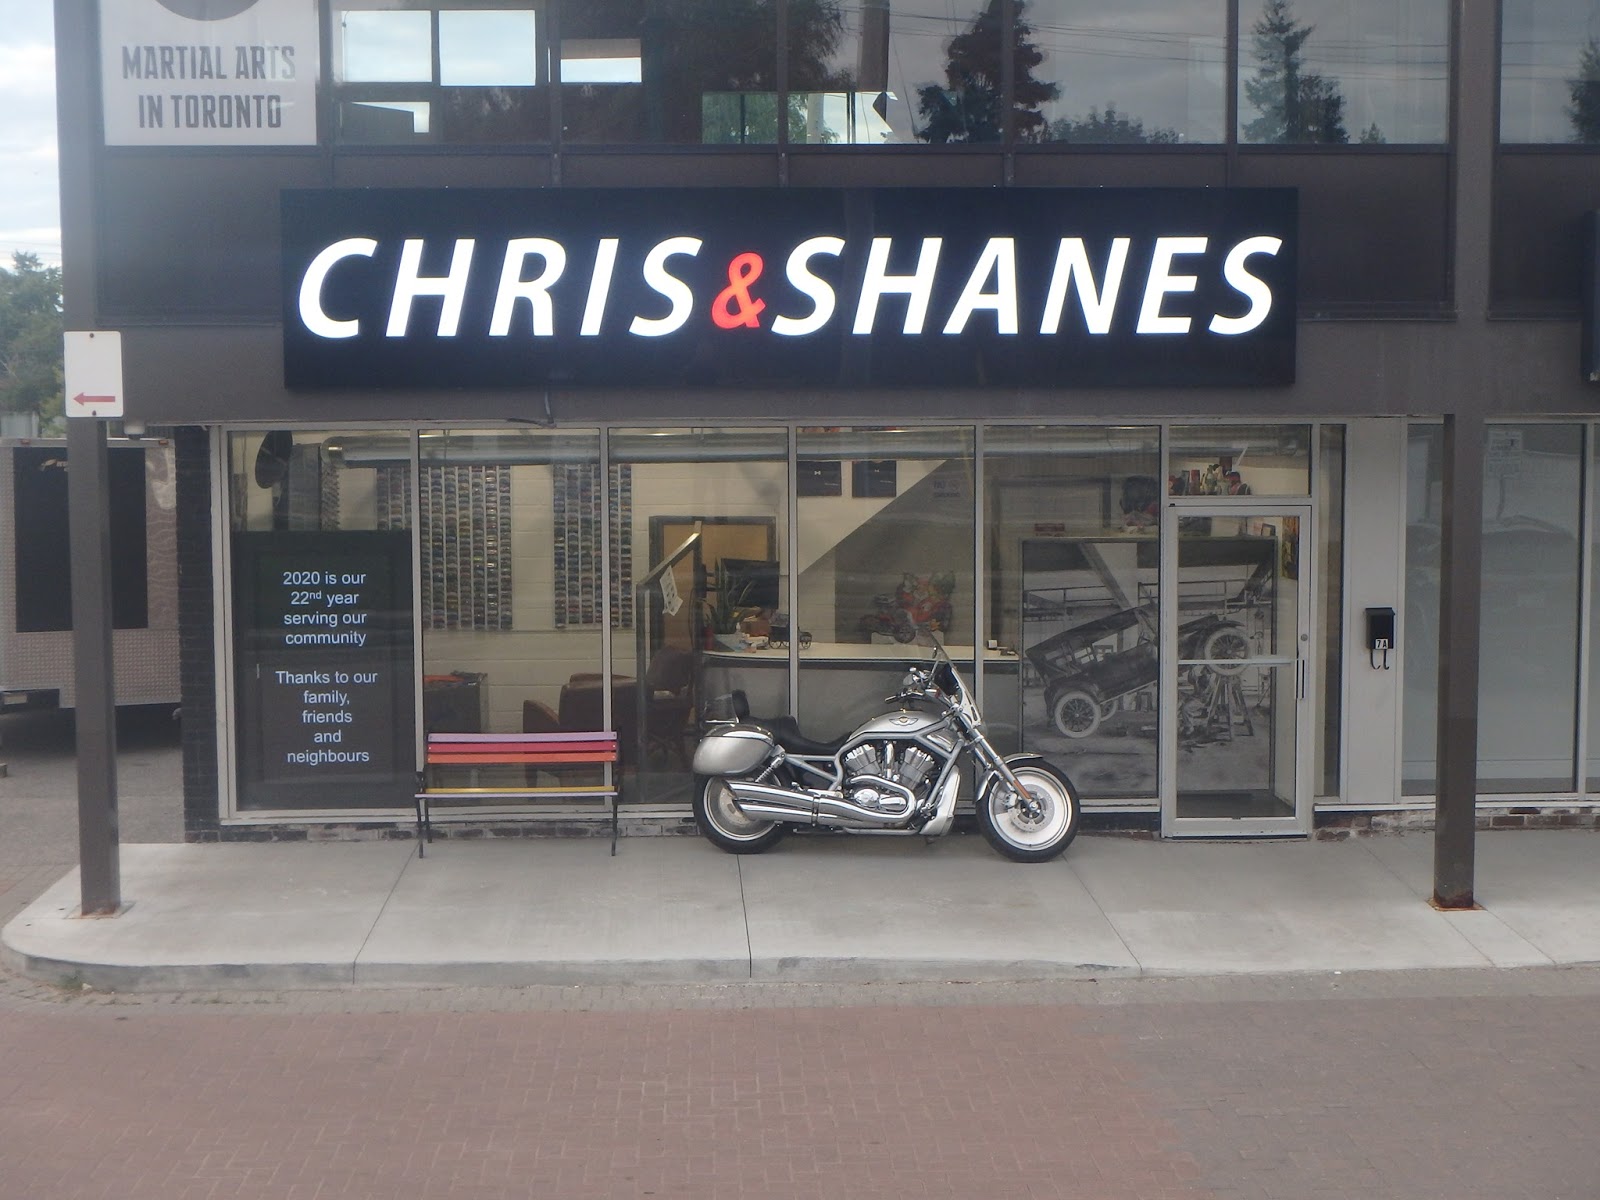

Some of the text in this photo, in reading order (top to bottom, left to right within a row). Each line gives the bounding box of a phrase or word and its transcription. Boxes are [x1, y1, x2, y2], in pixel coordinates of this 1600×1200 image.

[122, 46, 296, 80] MARTIAL ARTS
[138, 95, 282, 129] IN TORONTO
[298, 236, 703, 339] CHRIS
[770, 235, 1283, 337] SHANES
[282, 571, 367, 585] 2020 is our
[290, 590, 360, 608] 22nd year
[283, 610, 368, 628] serving our
[285, 630, 367, 647] community
[275, 670, 378, 685] Thanks to our
[303, 690, 350, 706] family,
[301, 709, 353, 724] friends
[313, 729, 342, 744] and
[287, 749, 370, 766] neighbours
